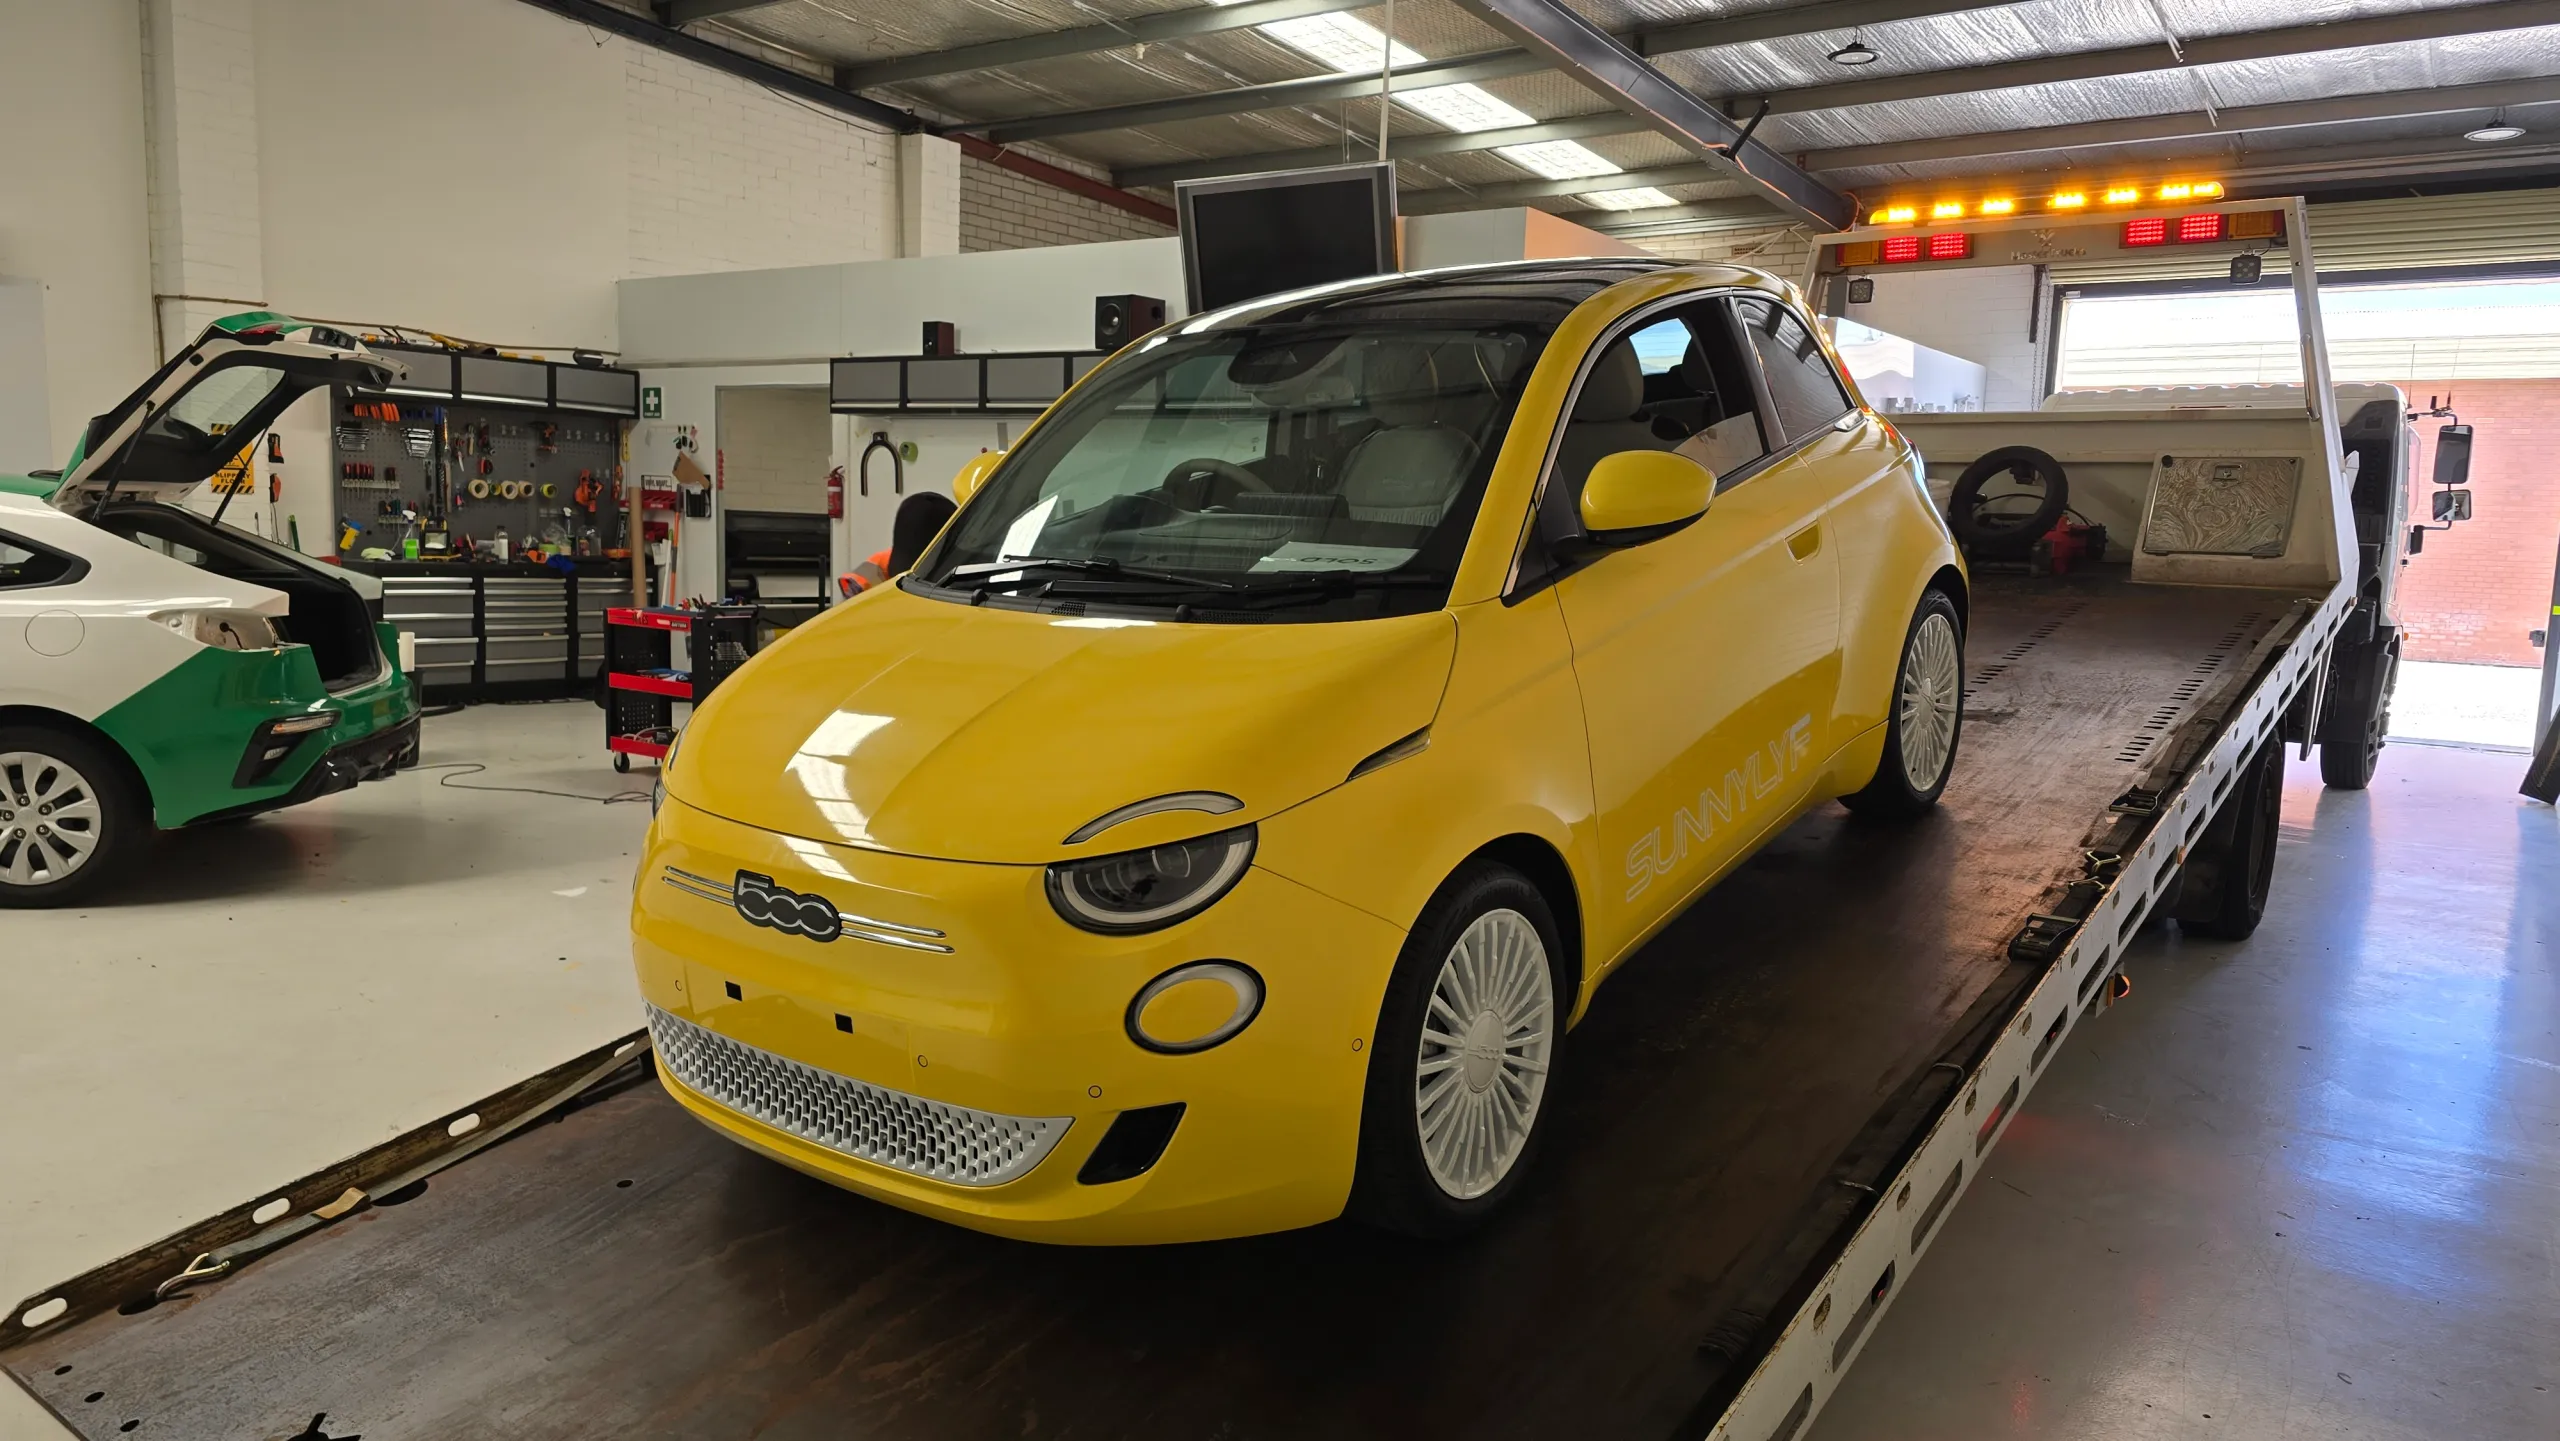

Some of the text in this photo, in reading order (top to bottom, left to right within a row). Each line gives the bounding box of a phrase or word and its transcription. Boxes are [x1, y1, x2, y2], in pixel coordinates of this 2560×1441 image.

[1300, 556, 1378, 565] SOLD
[1626, 713, 1811, 902] SUNNYLYF
[737, 876, 836, 936] 500
